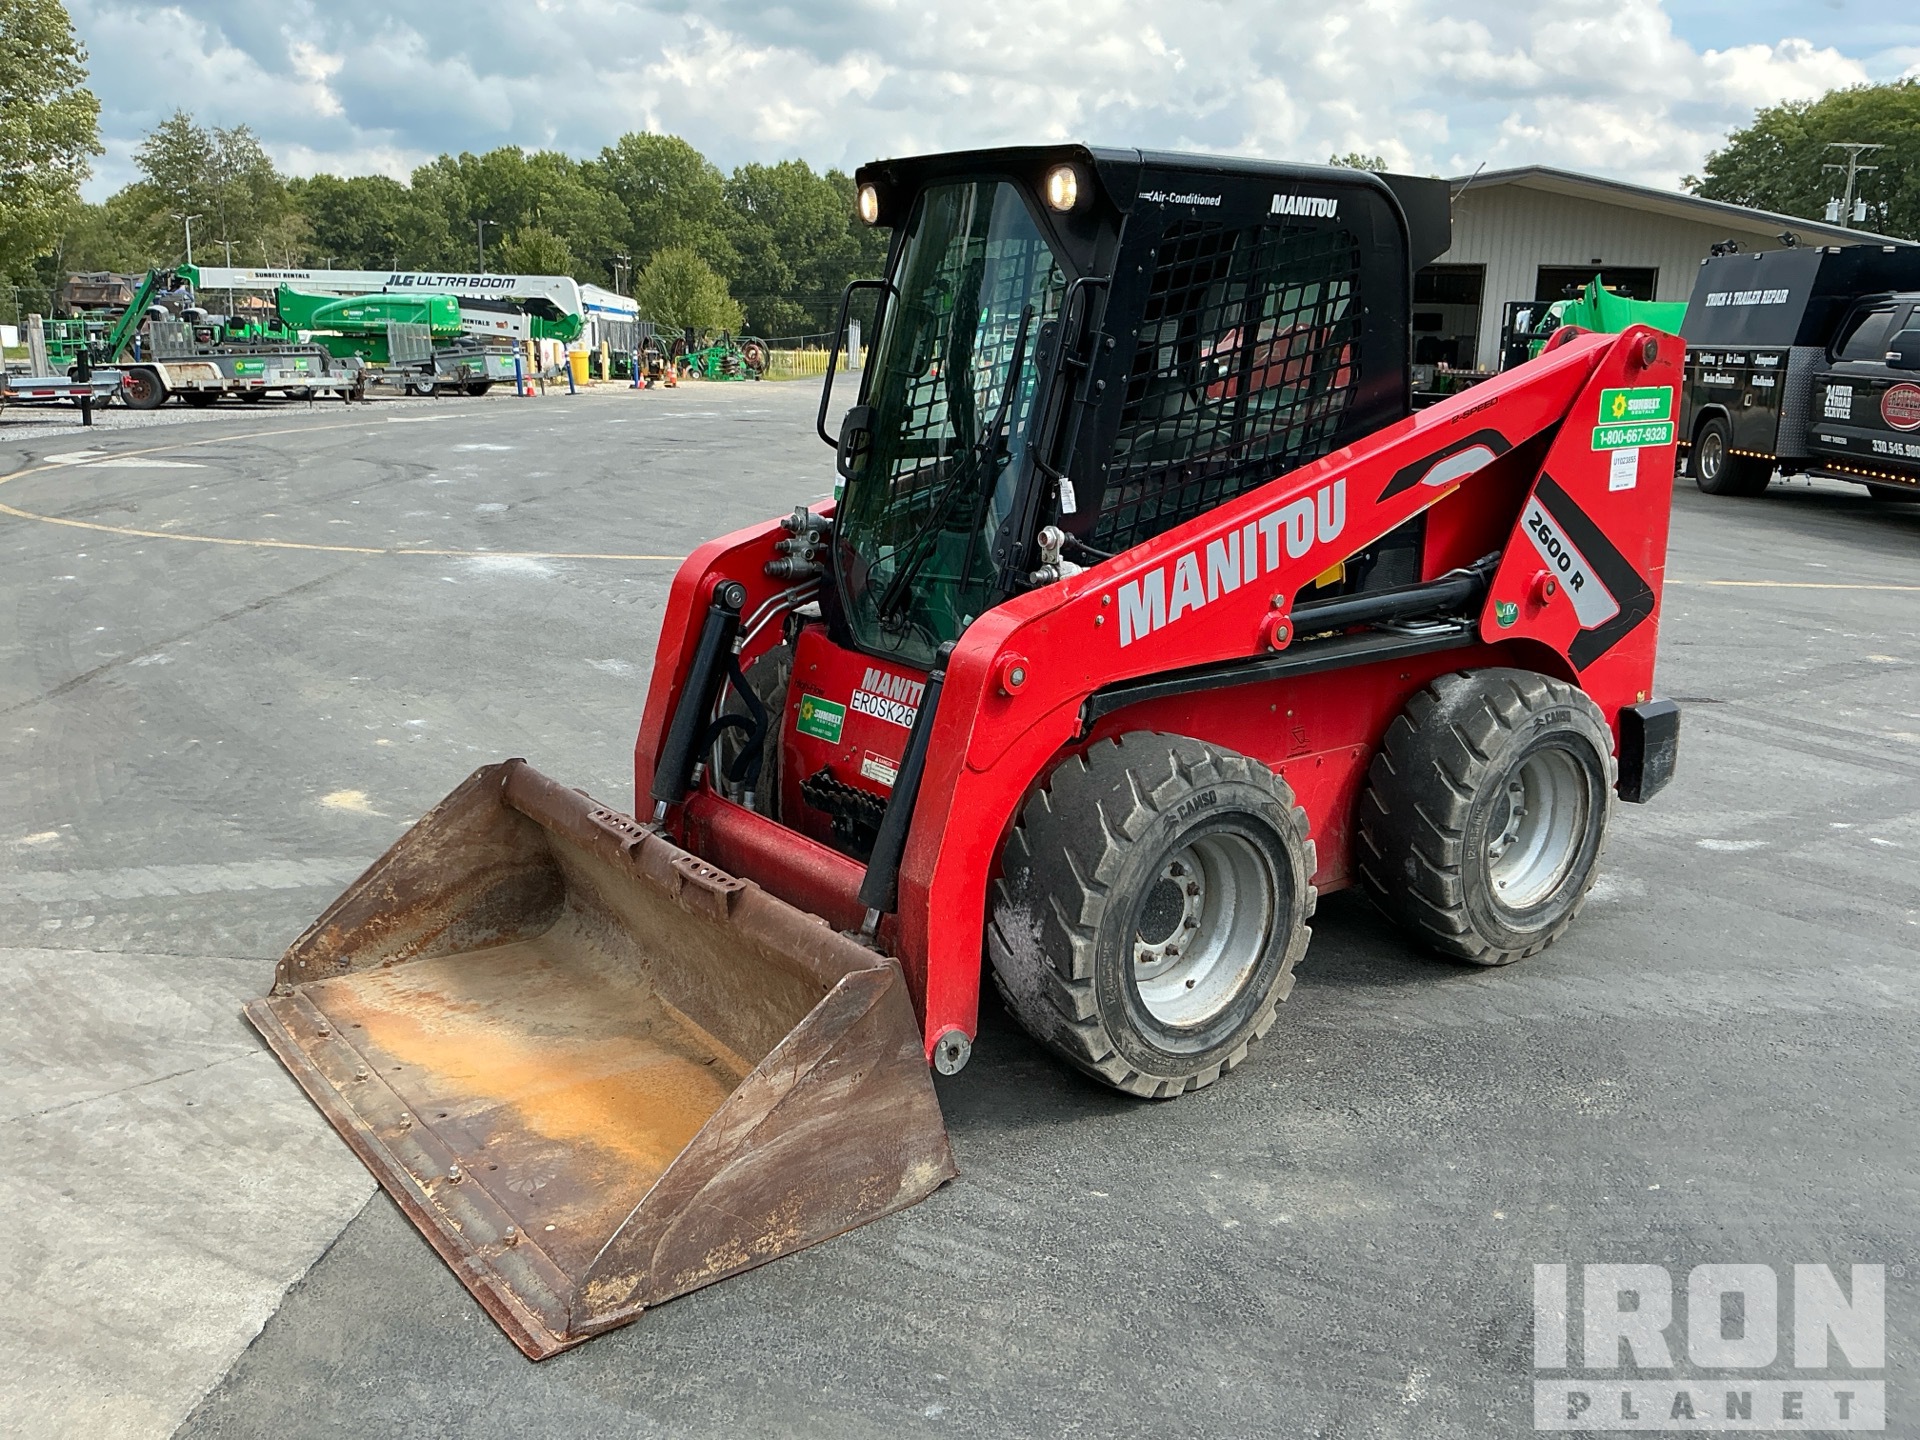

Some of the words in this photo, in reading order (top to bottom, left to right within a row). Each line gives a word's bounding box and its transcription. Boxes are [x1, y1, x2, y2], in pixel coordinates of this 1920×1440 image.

[1152, 191, 1221, 206] Air-Conditioned
[1270, 194, 1338, 218] MANITOU
[385, 275, 415, 287] JLG
[417, 276, 467, 288] ULTRA
[469, 277, 516, 289] BOOM
[1705, 292, 1728, 307] TRUCK
[1726, 292, 1733, 306] &
[1732, 290, 1762, 306] TRAILER
[1760, 289, 1789, 305] REPAIR
[1627, 398, 1661, 411] SUNBELT
[1825, 384, 1836, 407] 24
[1835, 385, 1853, 397] HOUR
[1834, 396, 1852, 408] ROAD
[1451, 397, 1499, 425] 2-SPEED
[1824, 406, 1851, 419] SERVICE
[1600, 426, 1668, 445] 1-800-667-9328
[1528, 511, 1571, 572] 2600
[1570, 570, 1585, 593] R
[1117, 478, 1347, 648] MANITOU
[861, 667, 926, 707] MANIT
[814, 709, 843, 725] SUNBELT
[1545, 710, 1571, 725] CAMSO
[1177, 789, 1217, 820] CAMSO
